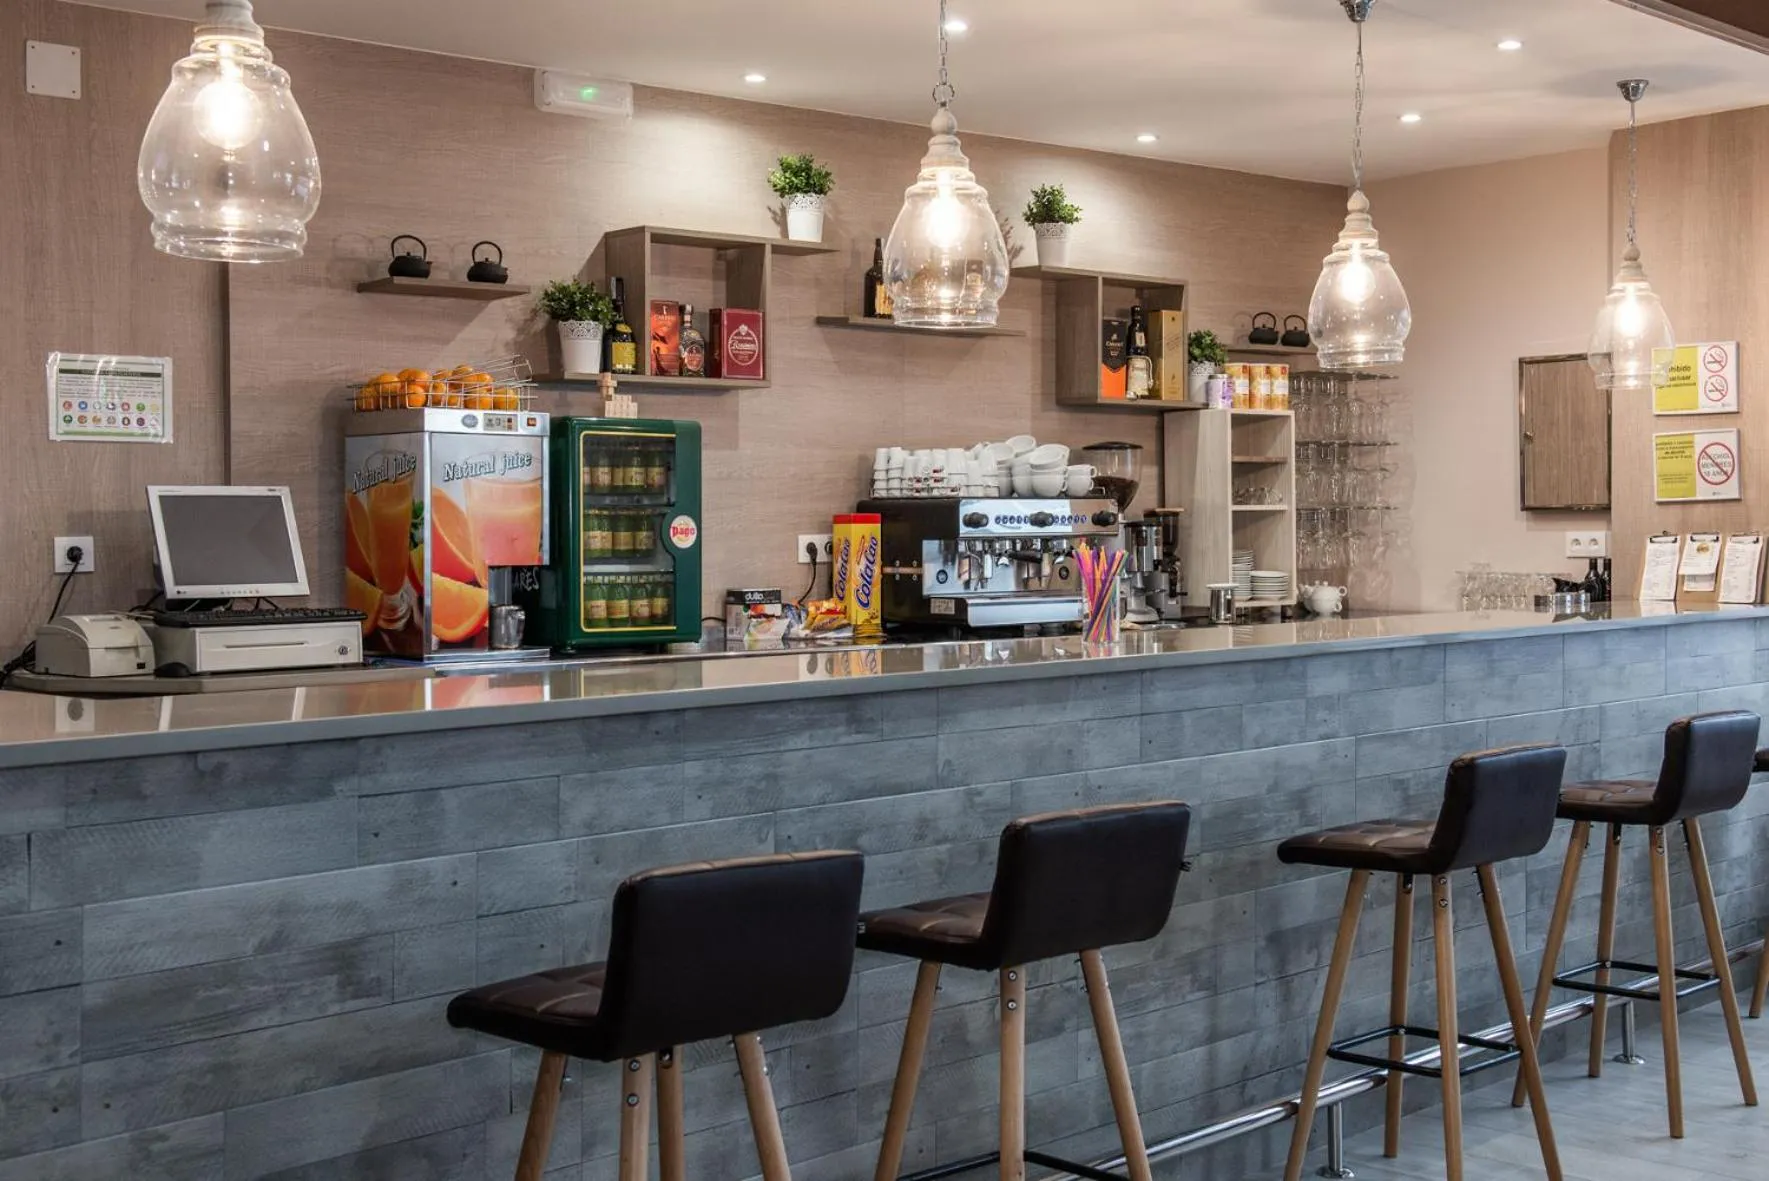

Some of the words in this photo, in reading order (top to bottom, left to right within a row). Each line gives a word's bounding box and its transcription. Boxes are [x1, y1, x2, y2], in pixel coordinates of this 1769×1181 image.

[353, 456, 389, 495] Natural
[392, 453, 417, 484] juice
[443, 455, 496, 482] Natural
[500, 453, 532, 476] juice
[671, 526, 695, 539] pago
